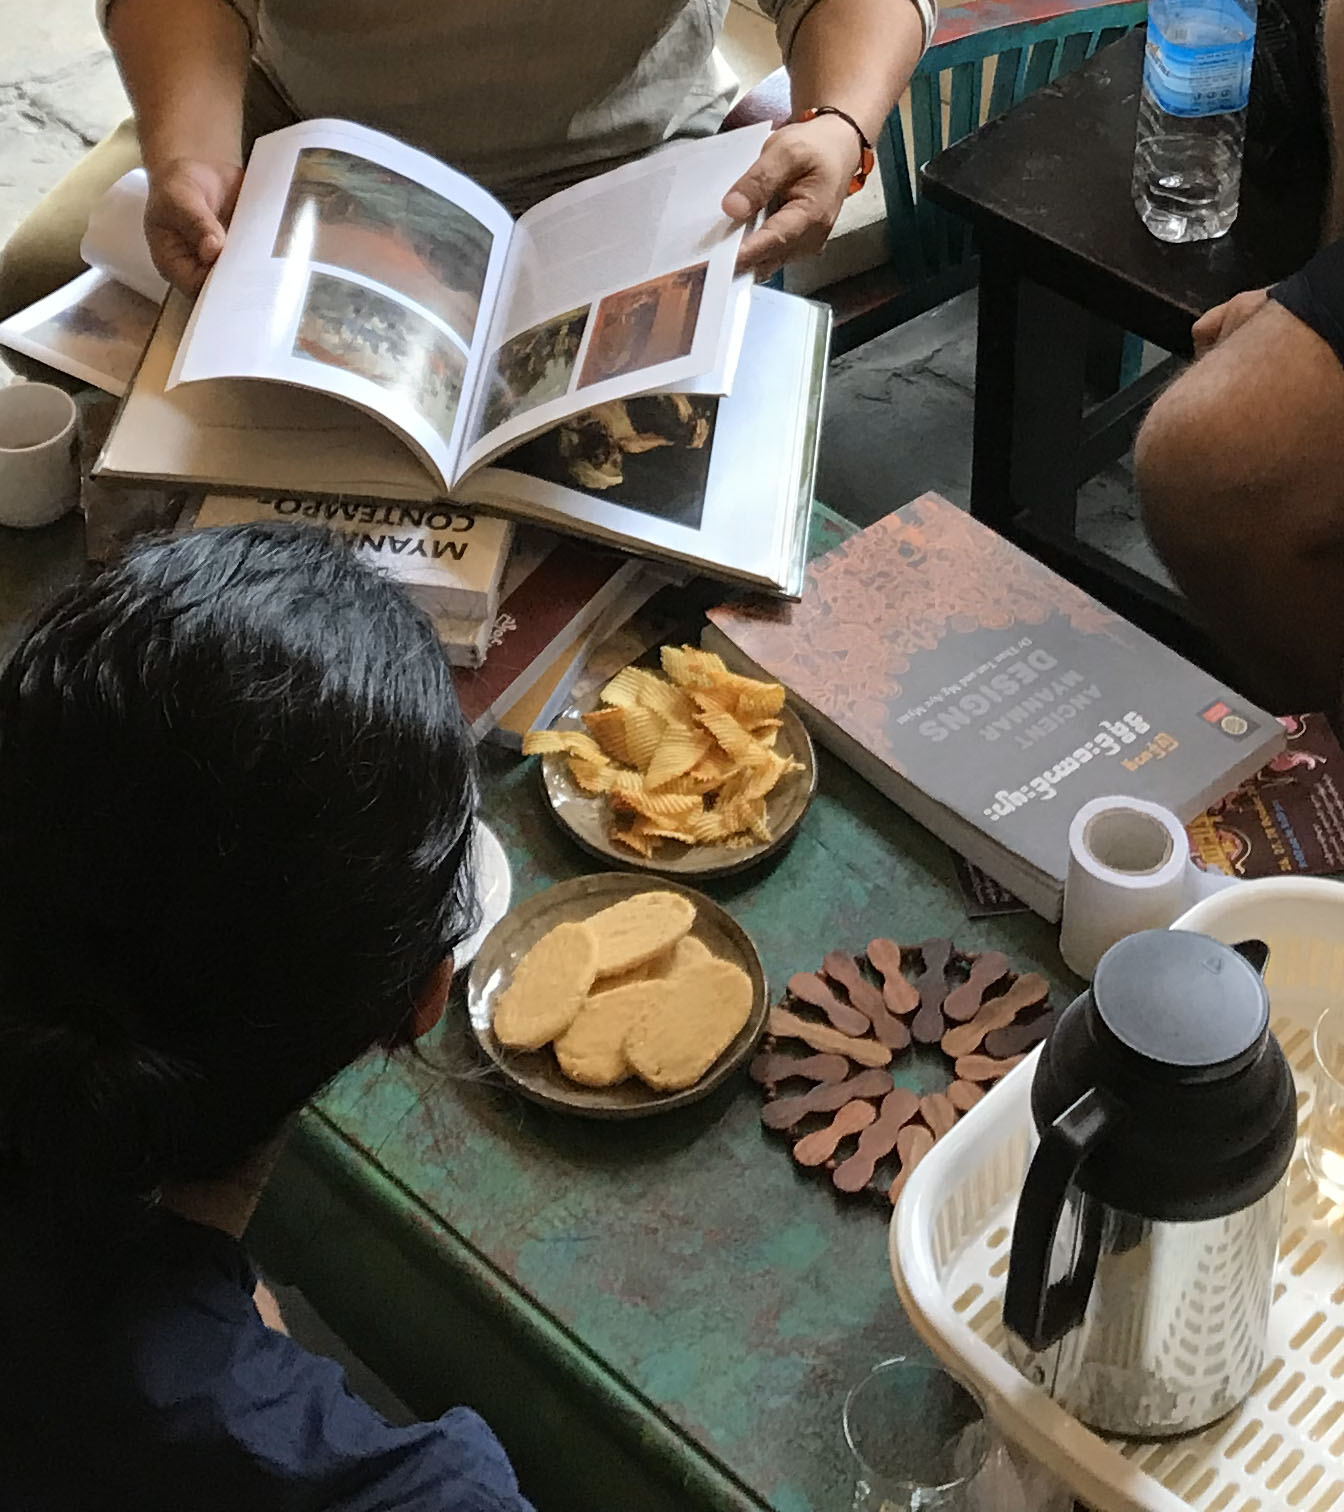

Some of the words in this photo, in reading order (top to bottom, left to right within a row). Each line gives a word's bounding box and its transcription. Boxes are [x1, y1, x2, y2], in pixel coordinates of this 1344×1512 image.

[918, 649, 1058, 742] DESIGNS
[979, 670, 1084, 741] MYANMAR
[1014, 684, 1102, 751] ANCIENT
